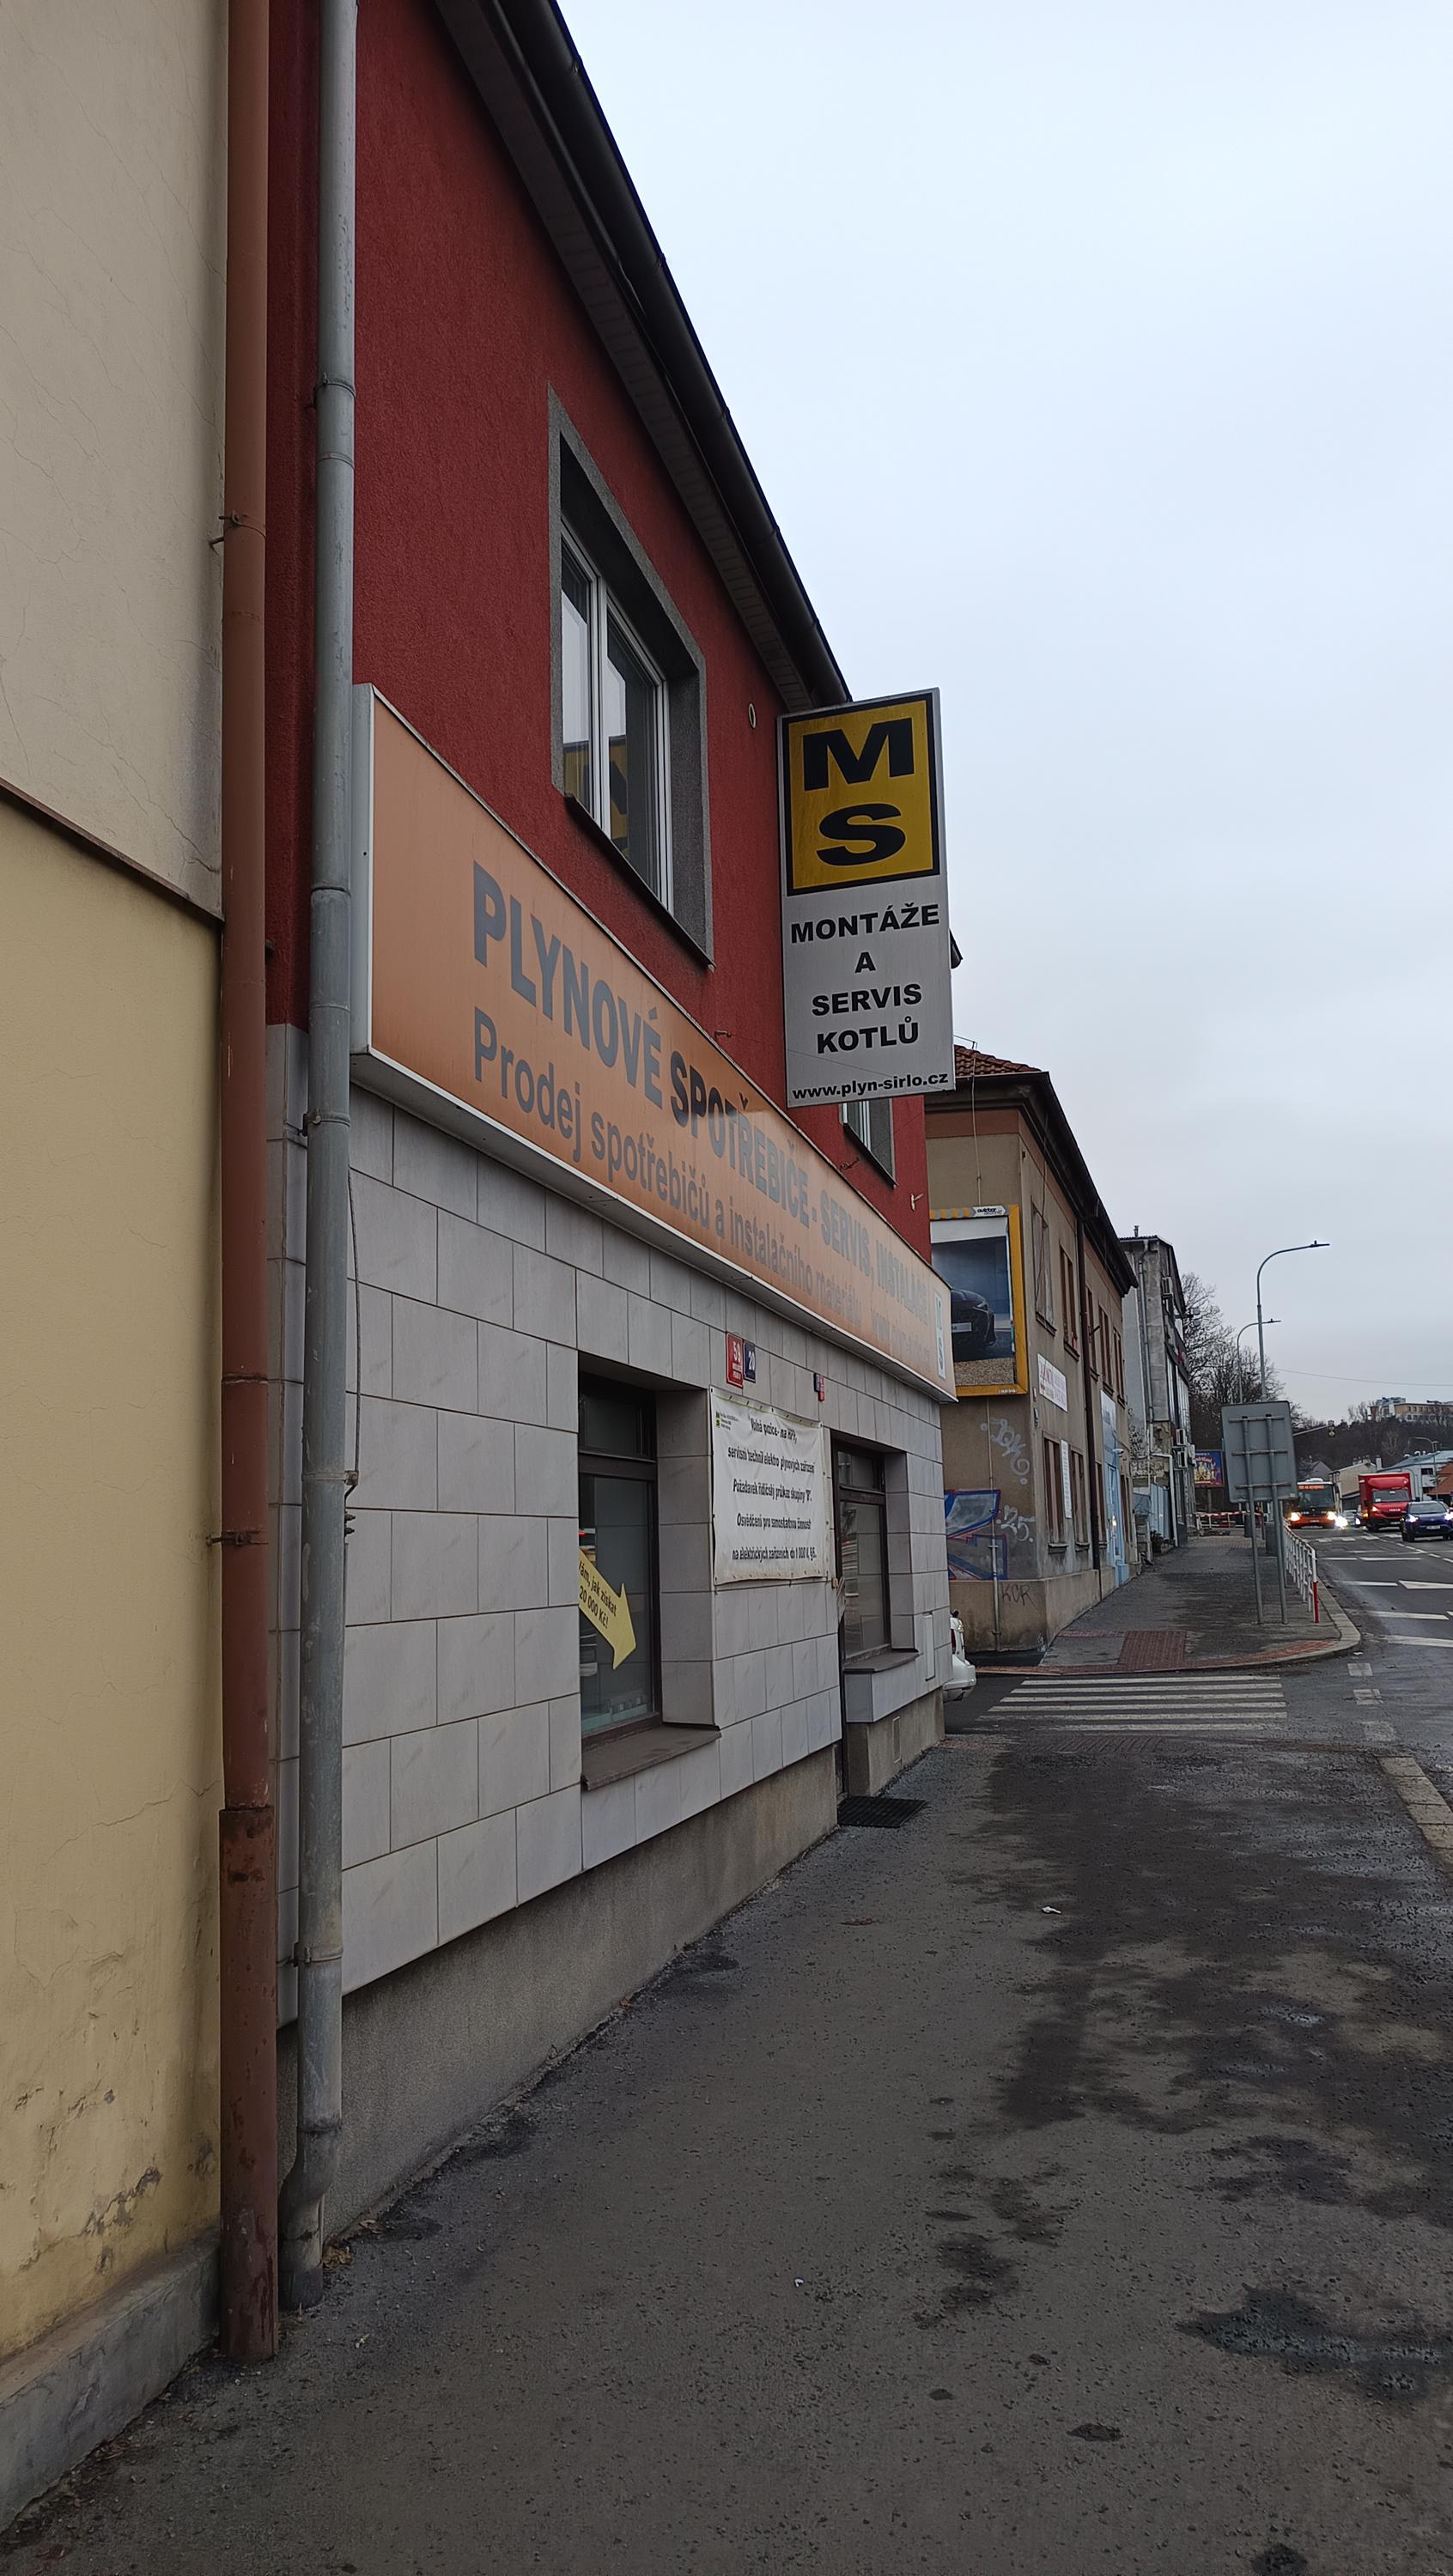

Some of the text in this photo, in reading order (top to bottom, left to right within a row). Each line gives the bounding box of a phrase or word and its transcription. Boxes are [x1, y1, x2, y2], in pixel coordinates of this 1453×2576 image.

[803, 717, 915, 792] M
[816, 803, 906, 866] S
[790, 902, 940, 944] MONTÁŽE
[854, 951, 877, 974] A
[812, 982, 923, 1017] SERVIS
[817, 1016, 920, 1054] KOTLŮ
[473, 860, 663, 1109] PLYNOVÉ
[670, 1049, 810, 1229] SPOTŘEBIČE
[820, 1190, 874, 1287] SERVIS,
[793, 1072, 949, 1100] www.plyn-sirlo.cz
[473, 1005, 581, 1163] Prodej
[592, 1109, 710, 1225] spotřebičů
[714, 1199, 726, 1238] a
[729, 1195, 813, 1296] instalačního
[579, 1585, 587, 1604] 20
[587, 1595, 599, 1617] 000
